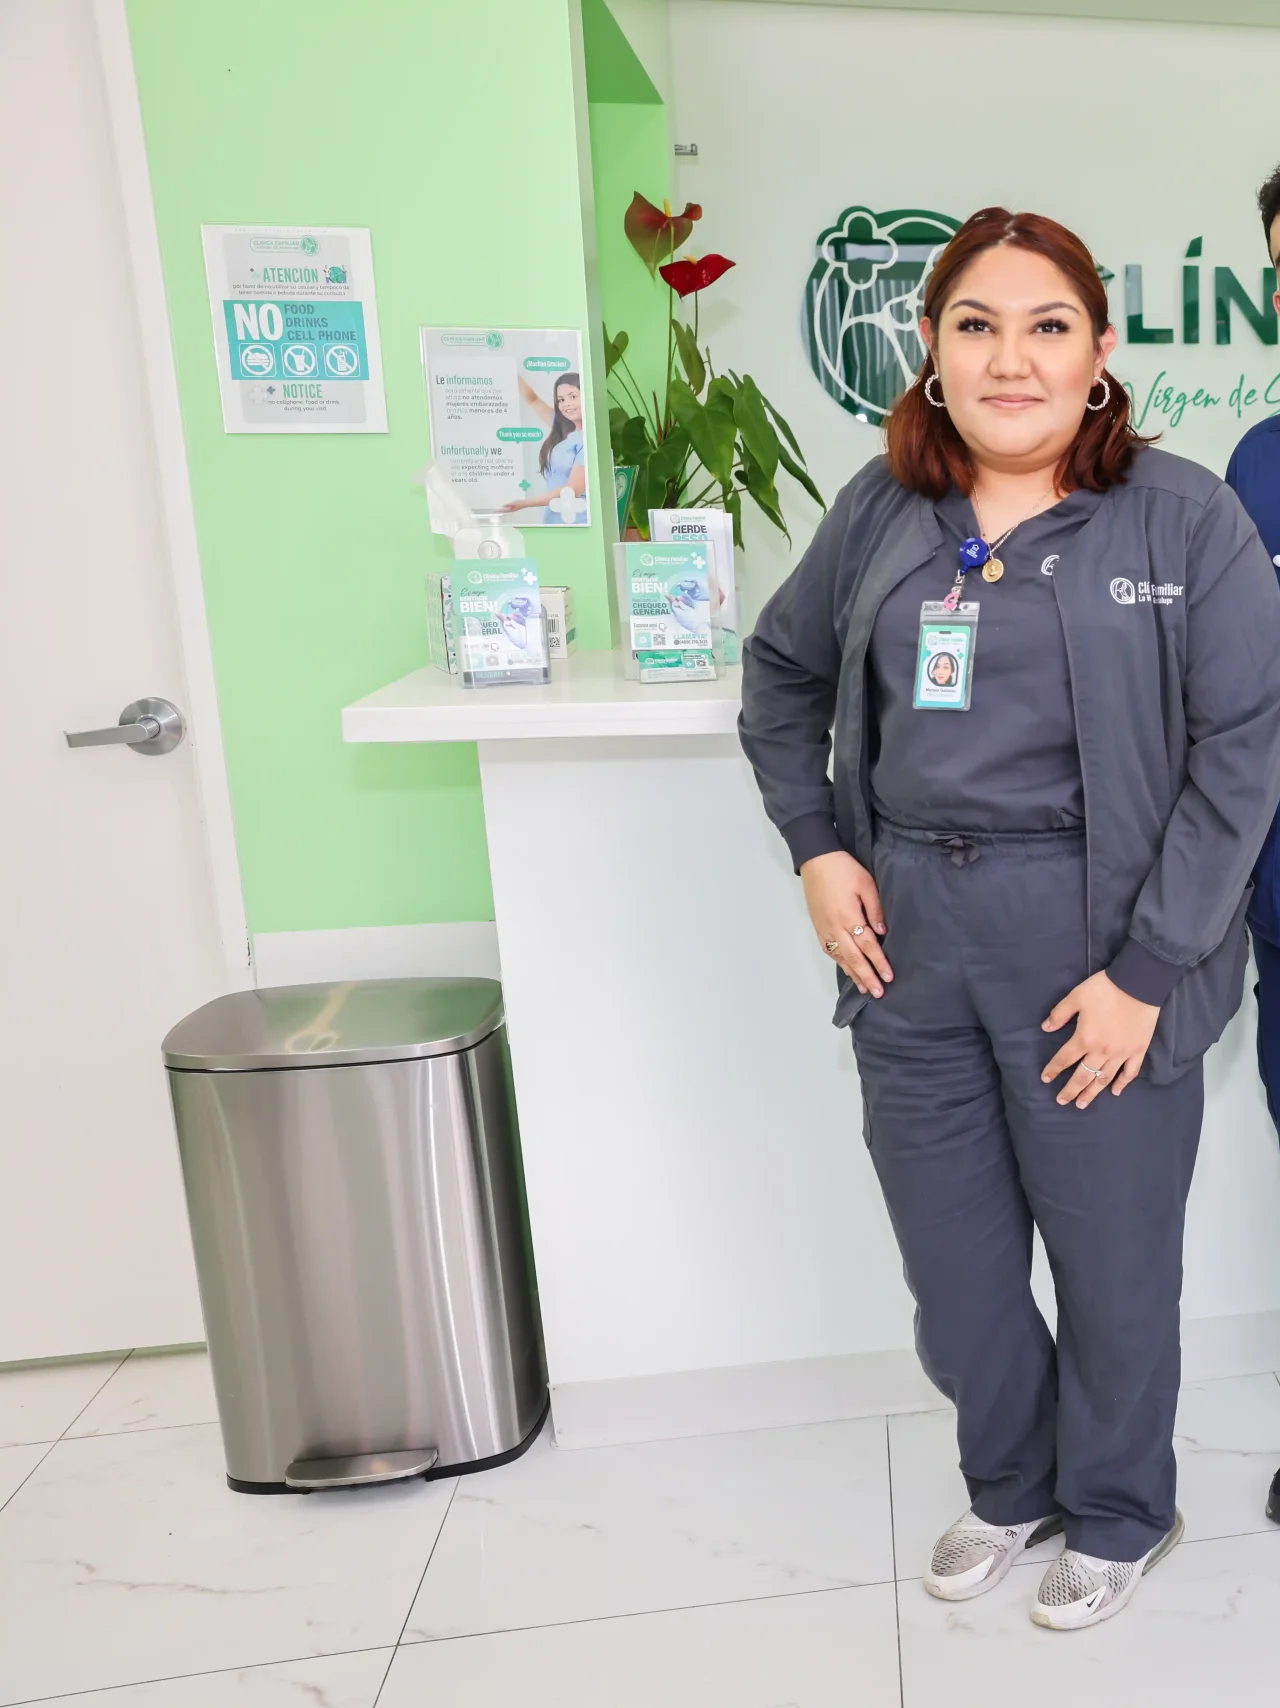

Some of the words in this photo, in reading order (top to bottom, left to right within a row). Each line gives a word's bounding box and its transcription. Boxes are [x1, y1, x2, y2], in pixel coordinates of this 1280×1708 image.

[263, 266, 318, 282] ATENCIÓN
[284, 304, 314, 315] FOOD
[233, 303, 283, 341] NO
[286, 318, 328, 328] DRINKS
[288, 331, 315, 340] CELL
[319, 331, 357, 340] PHONE
[436, 375, 445, 384] Le
[446, 375, 493, 385] informamos
[283, 384, 323, 398] NOTICE
[1122, 371, 1220, 429] Virgen
[1229, 374, 1257, 418] de
[441, 446, 488, 457] Unfortunally
[671, 525, 707, 534] PIERDE
[632, 582, 668, 593] BIEN!
